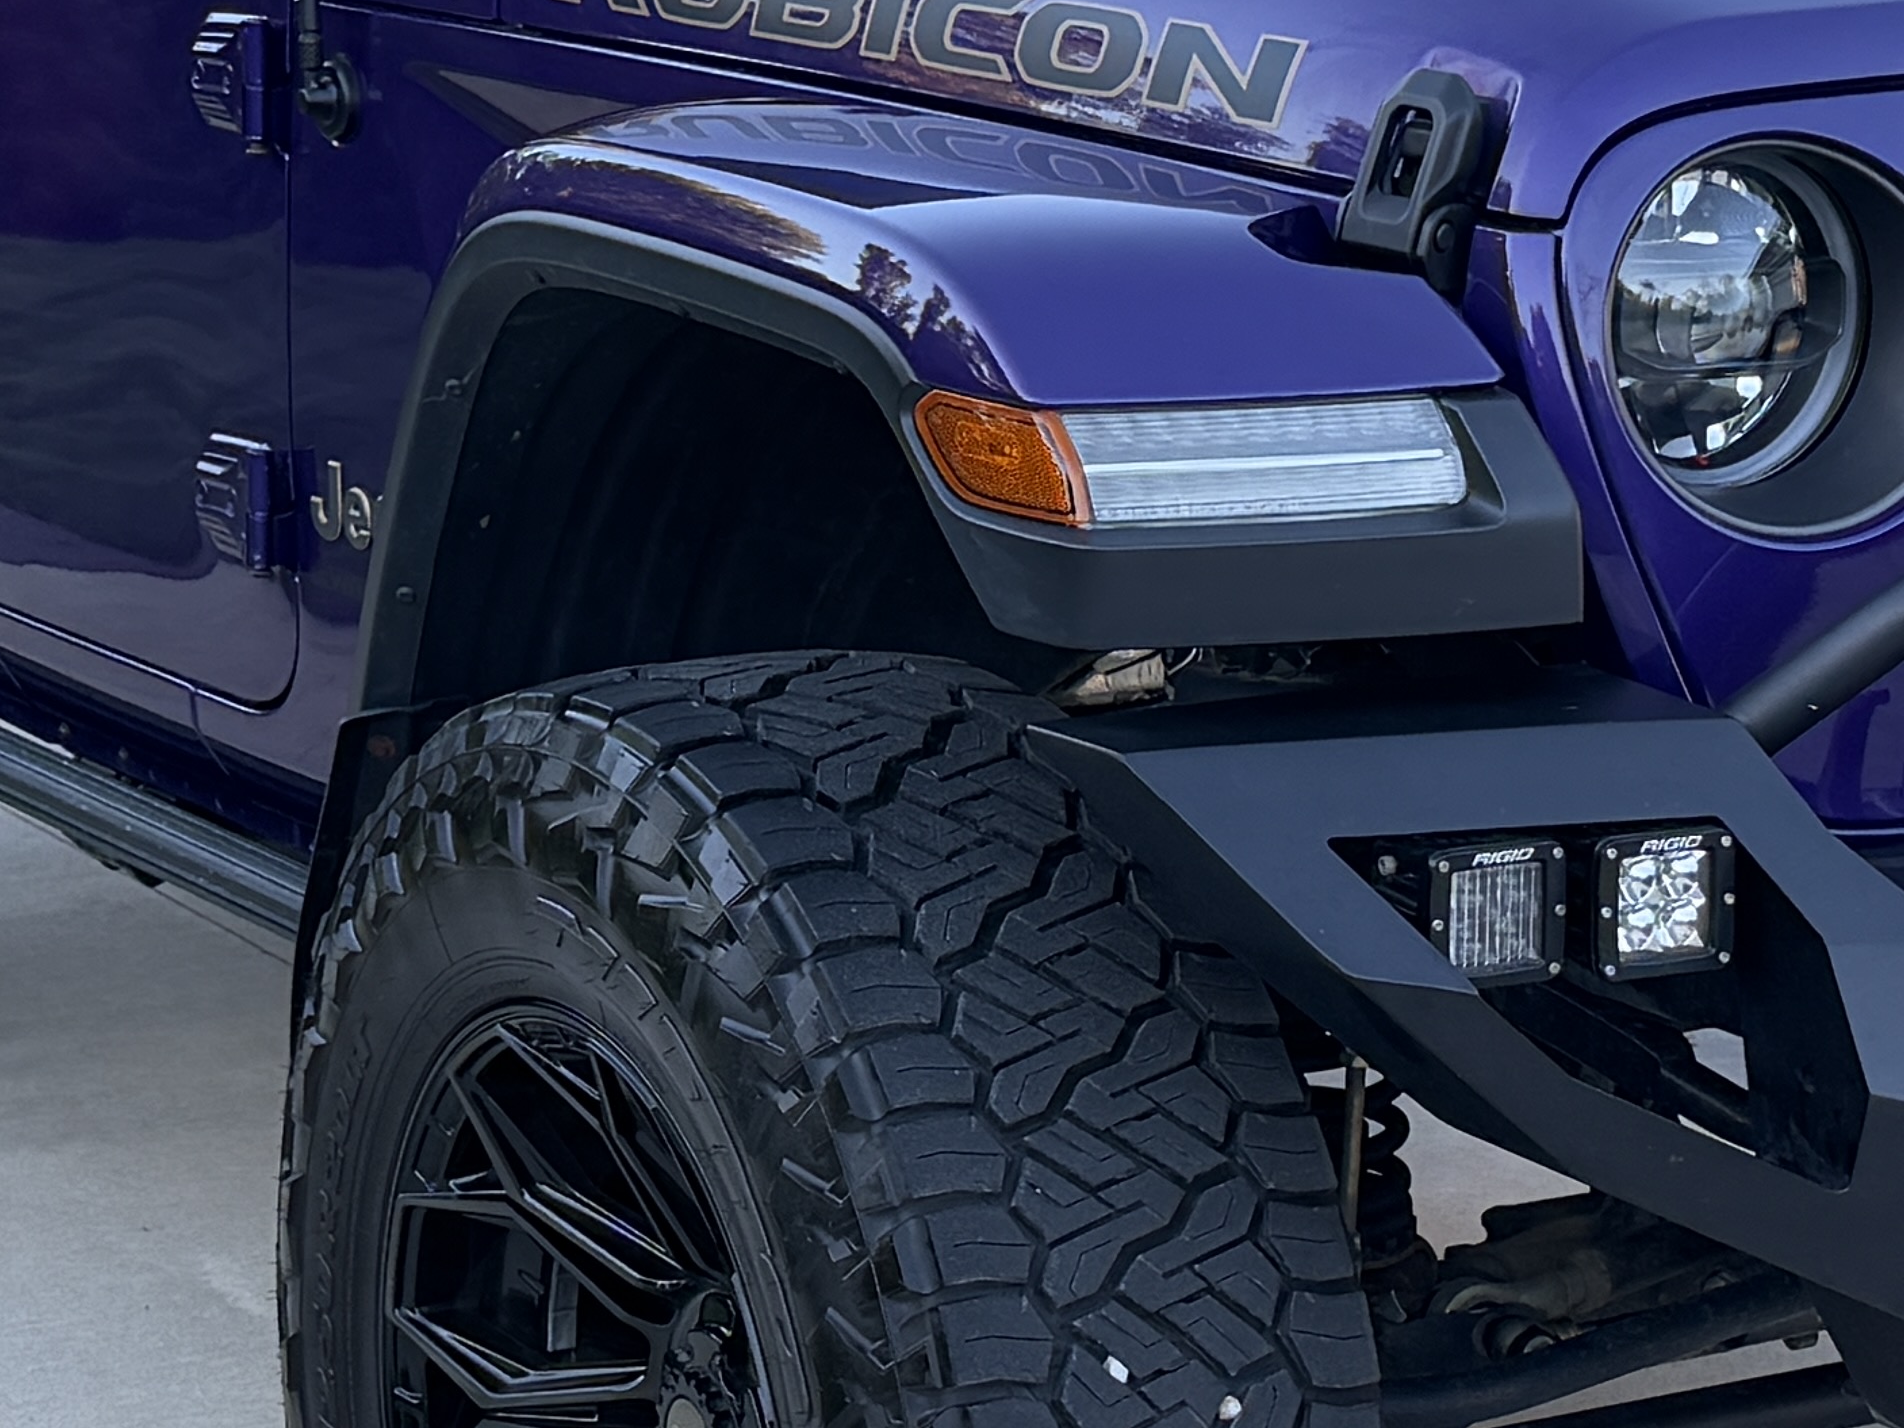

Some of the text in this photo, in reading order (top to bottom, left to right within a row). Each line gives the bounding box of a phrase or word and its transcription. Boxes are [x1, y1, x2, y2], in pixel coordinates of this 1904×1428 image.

[309, 459, 383, 552] Je
[1639, 834, 1703, 854] RIGID
[1471, 847, 1536, 867] RIGID
